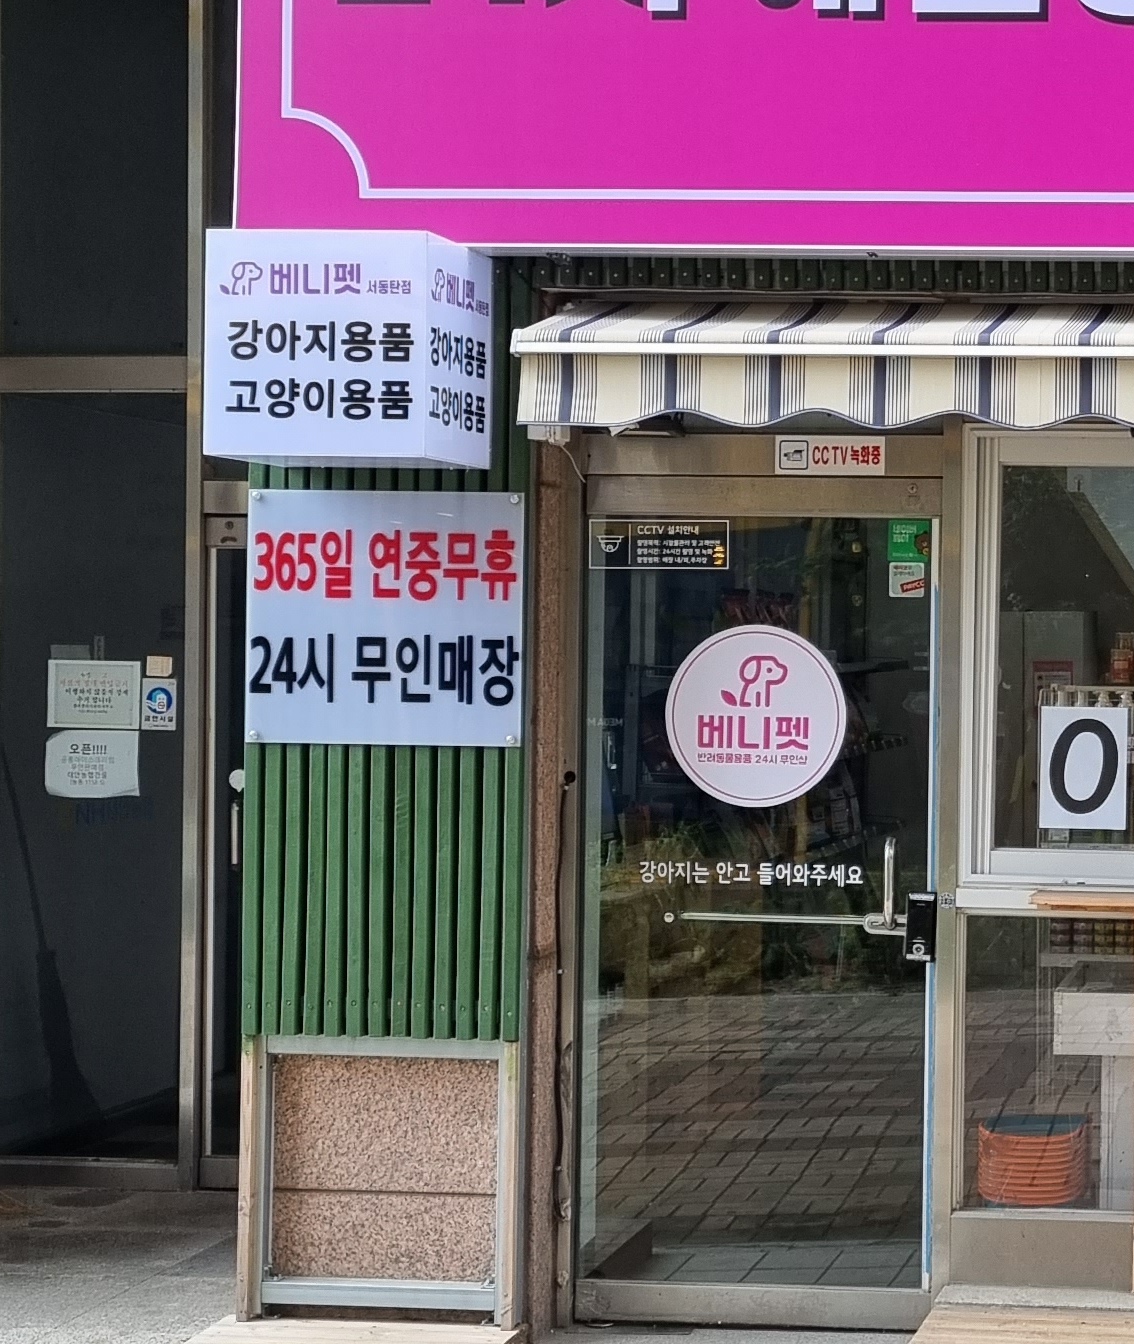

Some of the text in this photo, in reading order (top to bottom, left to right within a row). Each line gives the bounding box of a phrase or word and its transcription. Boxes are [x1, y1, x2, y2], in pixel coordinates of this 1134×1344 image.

[269, 263, 412, 295] 베니펫 서동탄점
[446, 273, 475, 312] 베니펫
[227, 320, 414, 362] 강아지용품
[430, 327, 487, 379] 강아지용품
[225, 378, 413, 420] 고양이용품
[429, 386, 486, 433] 고양이용품
[637, 525, 664, 535] CCTV
[253, 529, 518, 602] 365일 연중무휴
[249, 633, 519, 706] 24시 무인매장
[697, 715, 809, 750] 베니펫
[697, 753, 751, 764] 반려동물용품
[755, 755, 777, 765] 24시
[639, 861, 863, 887] 강아지는 안고 들어와주세요
